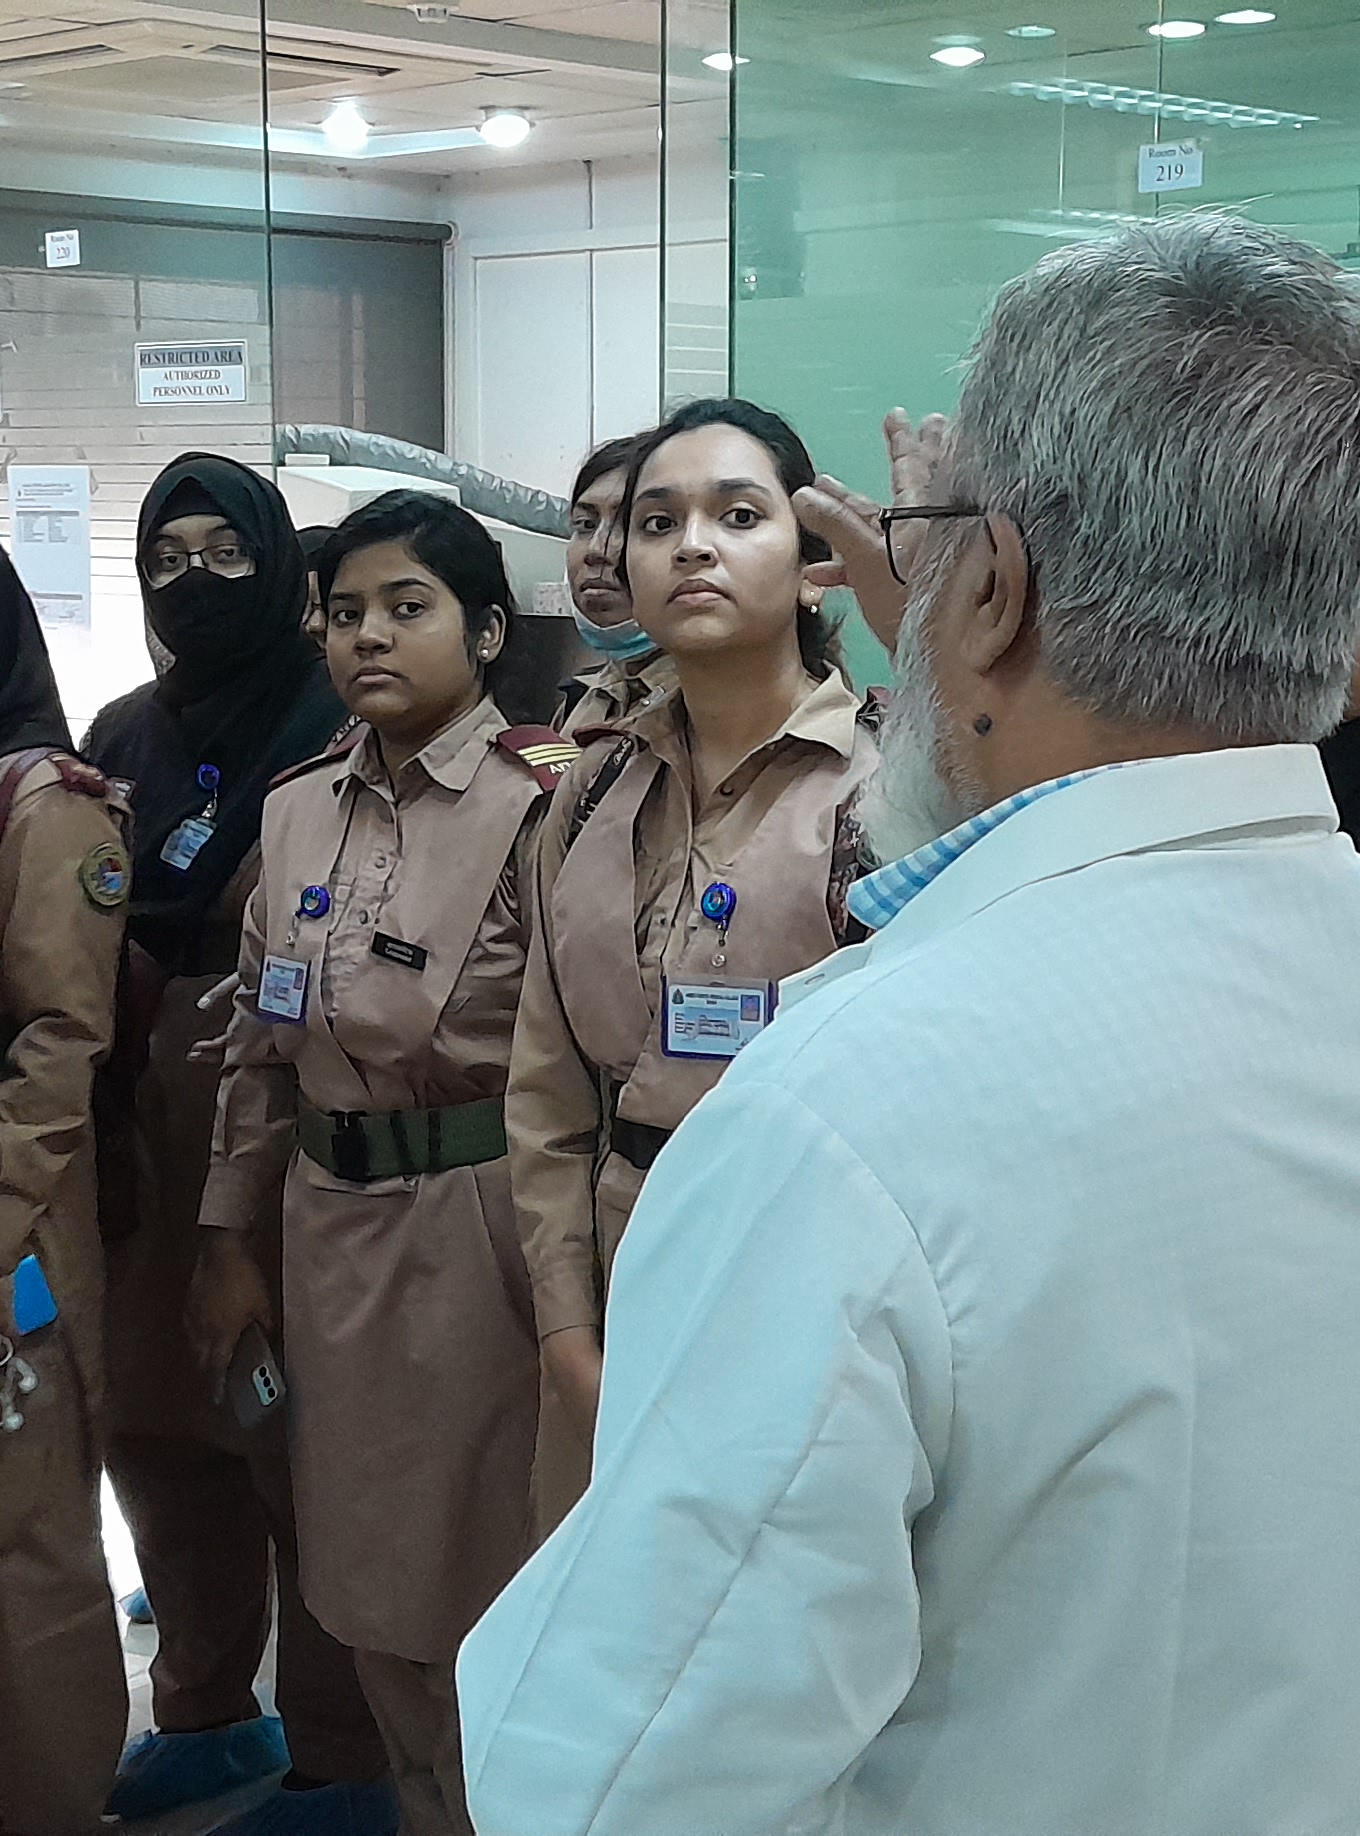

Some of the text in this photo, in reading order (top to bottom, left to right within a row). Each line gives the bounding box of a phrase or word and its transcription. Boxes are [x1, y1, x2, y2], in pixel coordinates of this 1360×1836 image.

[1155, 163, 1184, 182] 219
[140, 350, 244, 366] RESTRICTED AREA
[163, 369, 221, 381] AUTHORIZED
[153, 384, 231, 397] PERSONNEL ONLY
